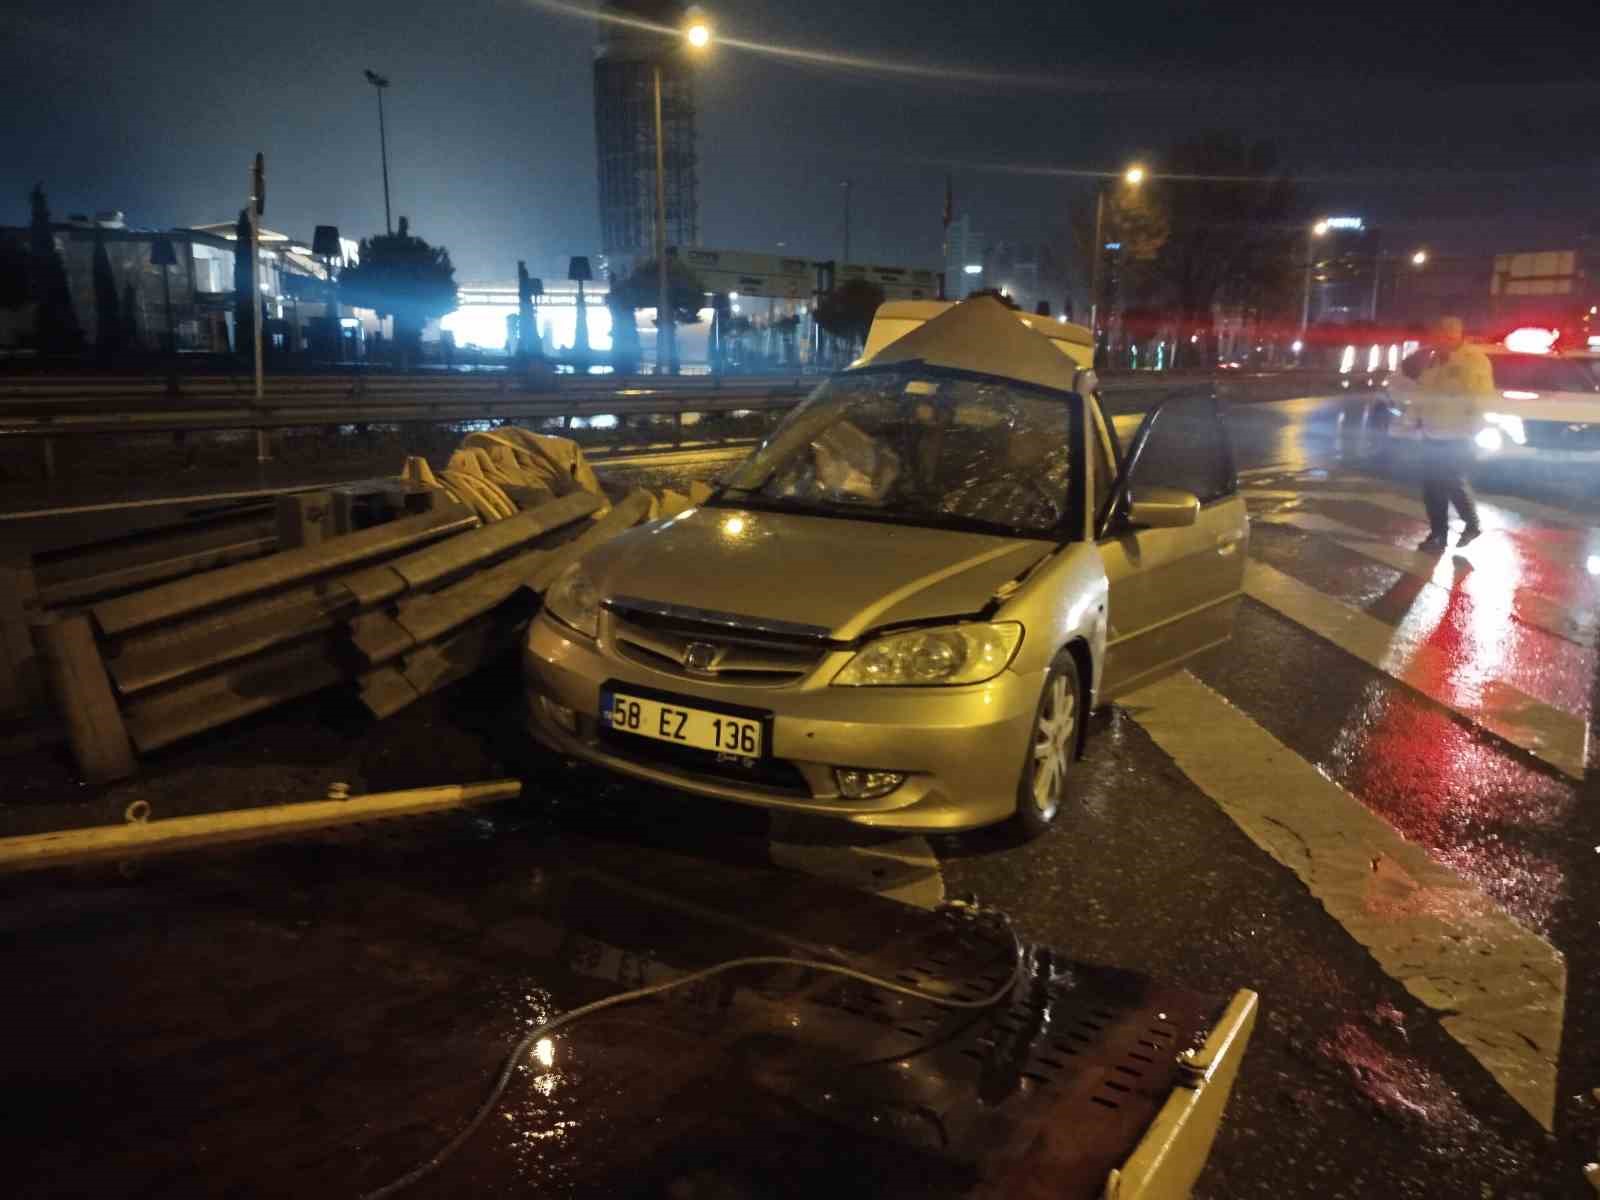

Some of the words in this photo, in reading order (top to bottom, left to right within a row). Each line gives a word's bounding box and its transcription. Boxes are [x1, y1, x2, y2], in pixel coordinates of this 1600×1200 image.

[615, 698, 641, 729] 58
[659, 708, 688, 740] EZ
[713, 719, 755, 752] 136
